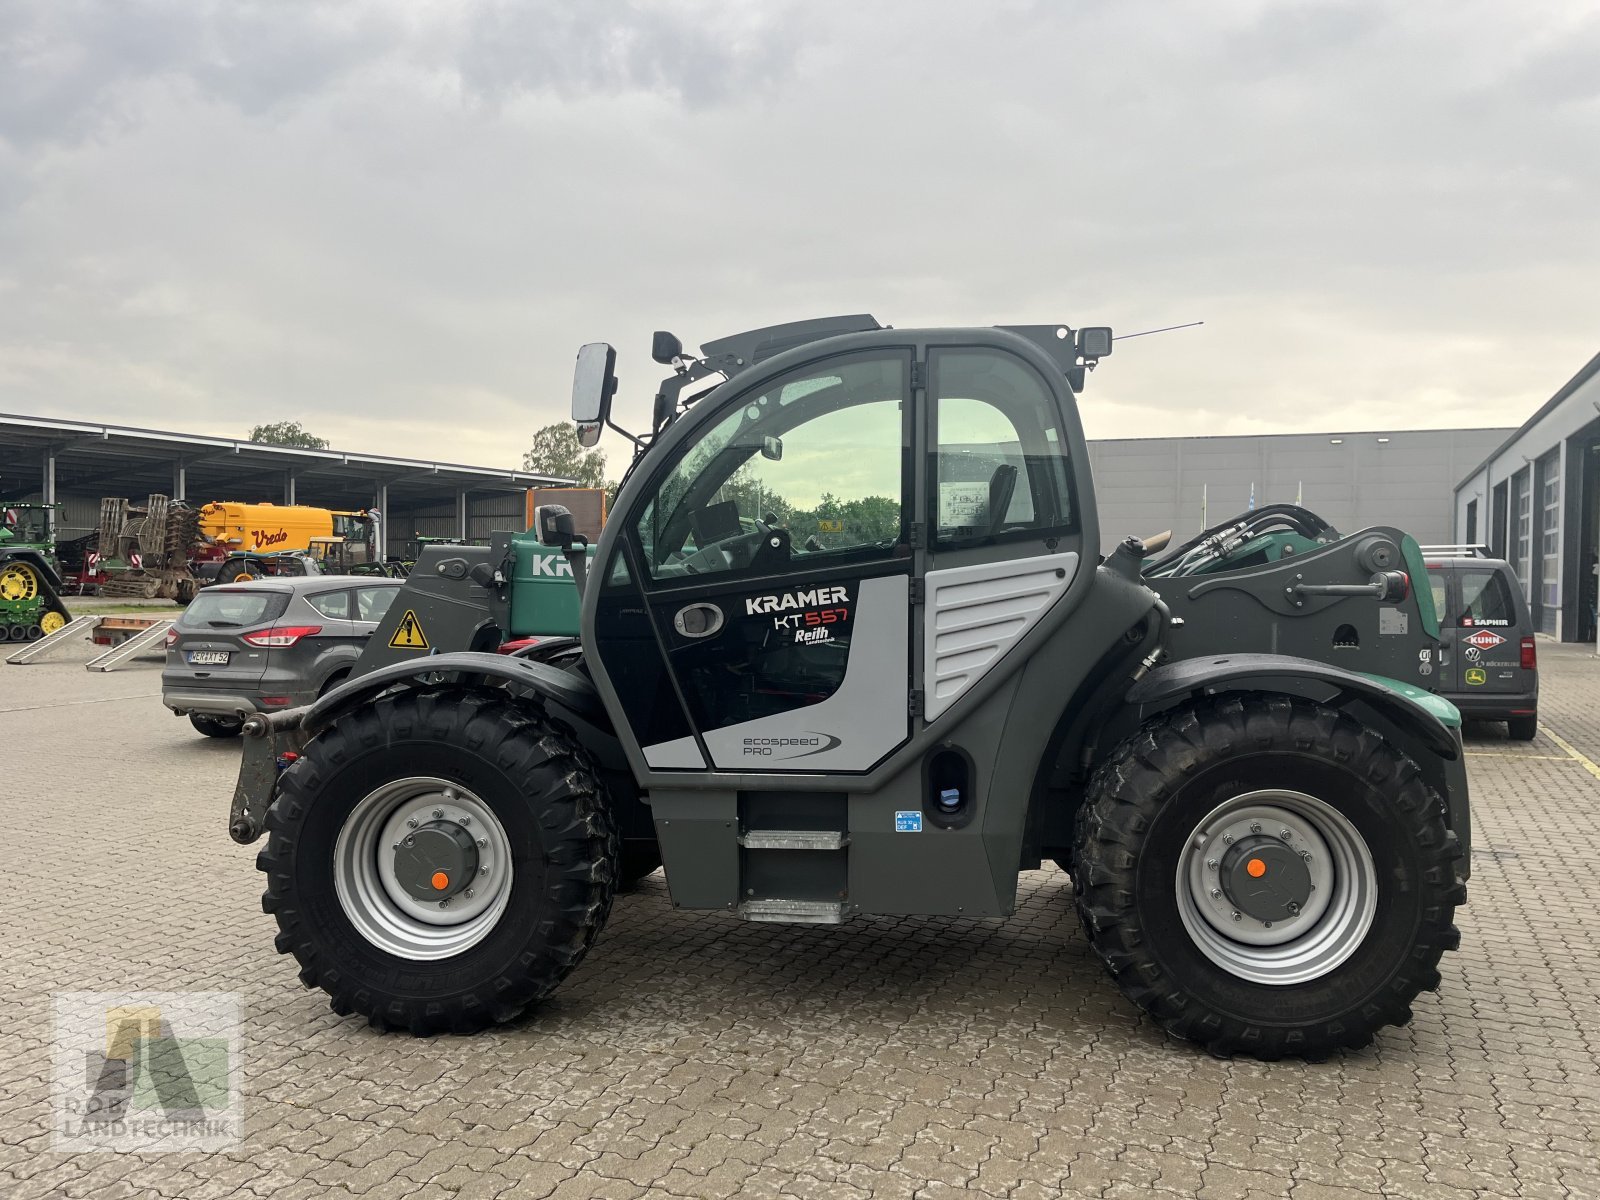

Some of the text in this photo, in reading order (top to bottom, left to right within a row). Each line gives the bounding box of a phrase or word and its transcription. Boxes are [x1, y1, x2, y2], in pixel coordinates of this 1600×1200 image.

[251, 528, 288, 548] Vredo
[745, 586, 850, 615] KRAMER
[794, 626, 829, 643] Reith
[1470, 636, 1500, 644] KUHN
[218, 652, 229, 662] 52
[743, 737, 819, 747] ecospeed
[743, 747, 772, 756] PRO
